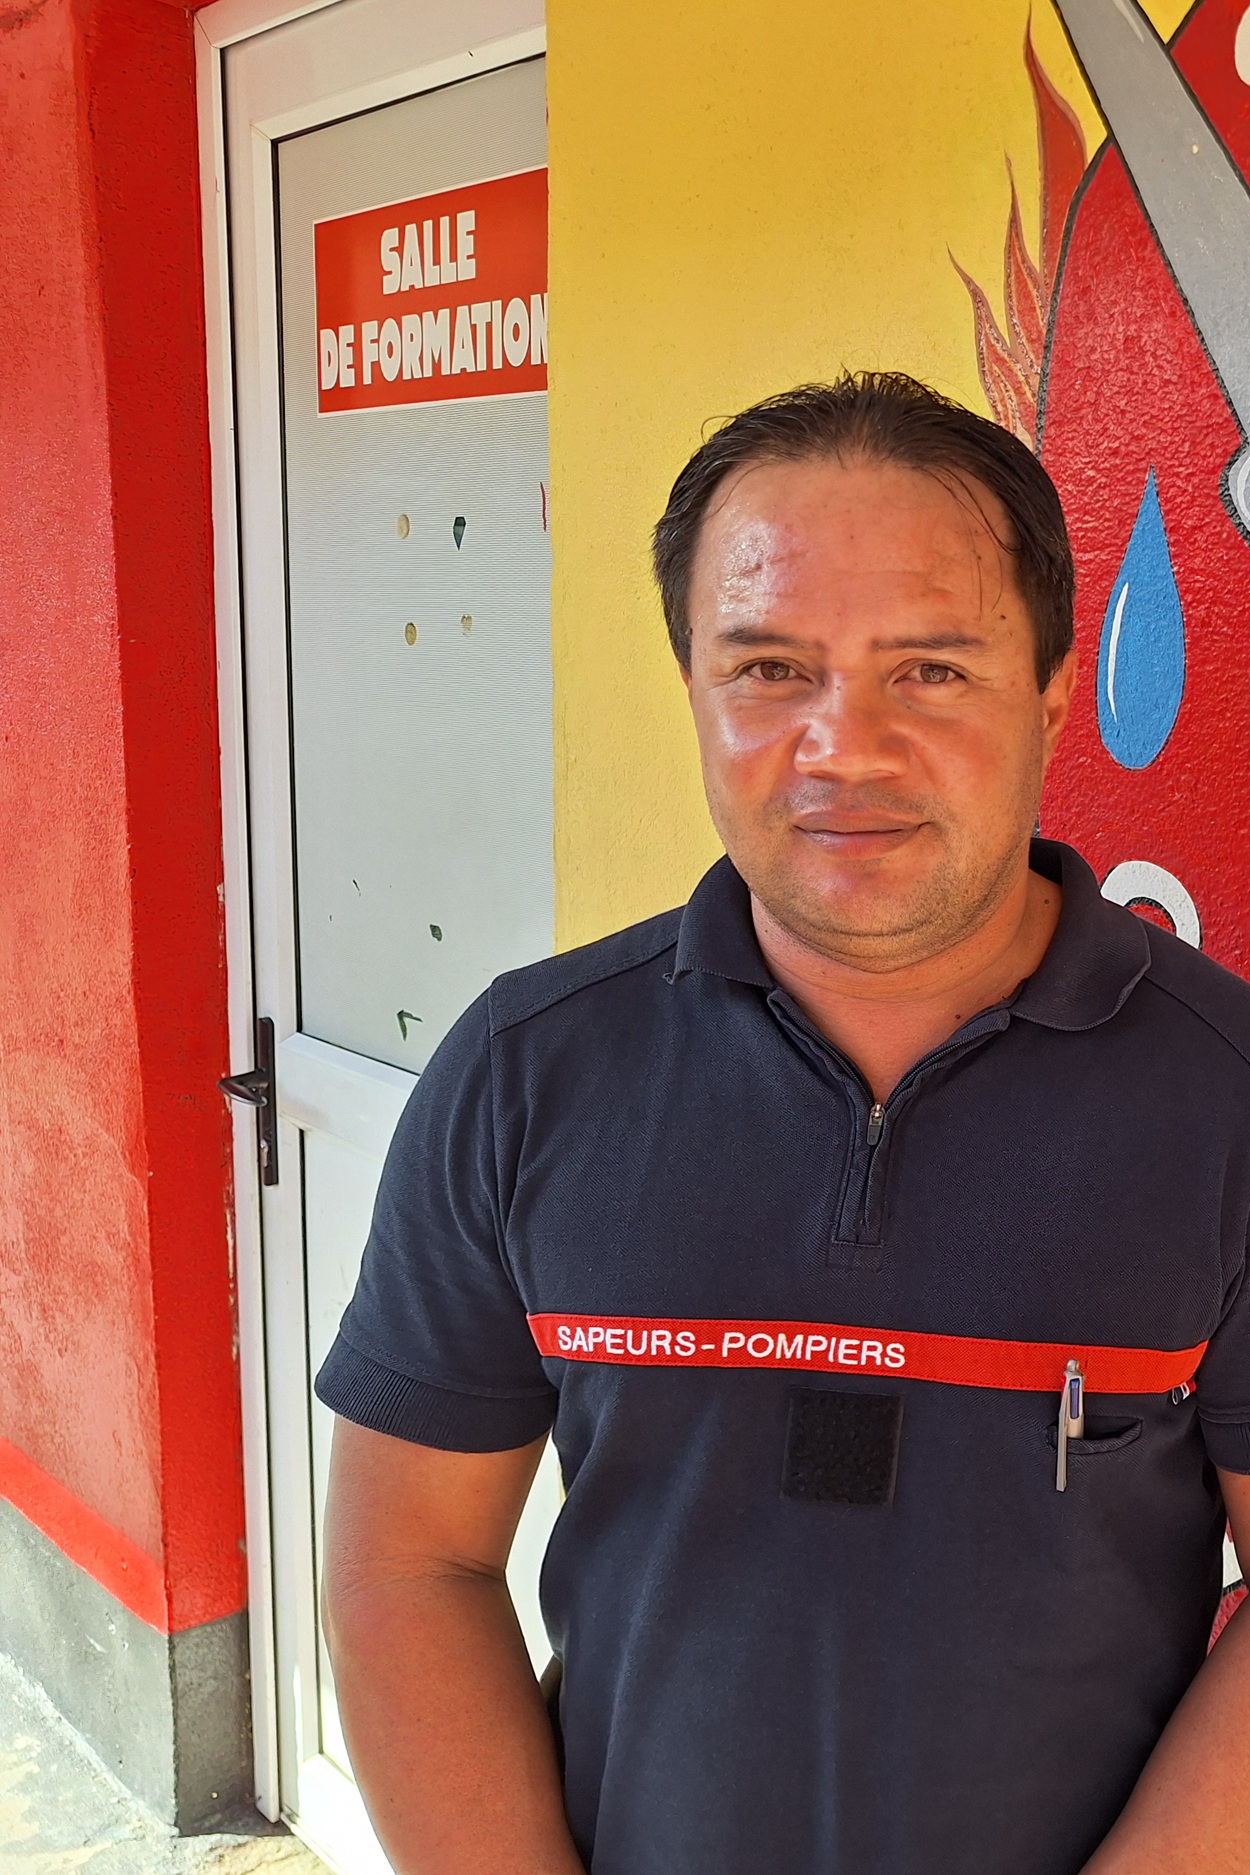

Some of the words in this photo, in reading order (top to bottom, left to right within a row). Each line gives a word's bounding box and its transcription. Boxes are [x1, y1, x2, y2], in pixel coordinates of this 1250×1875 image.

[380, 210, 476, 295] SALLE
[319, 324, 356, 391] DE
[361, 292, 548, 386] FORMATION
